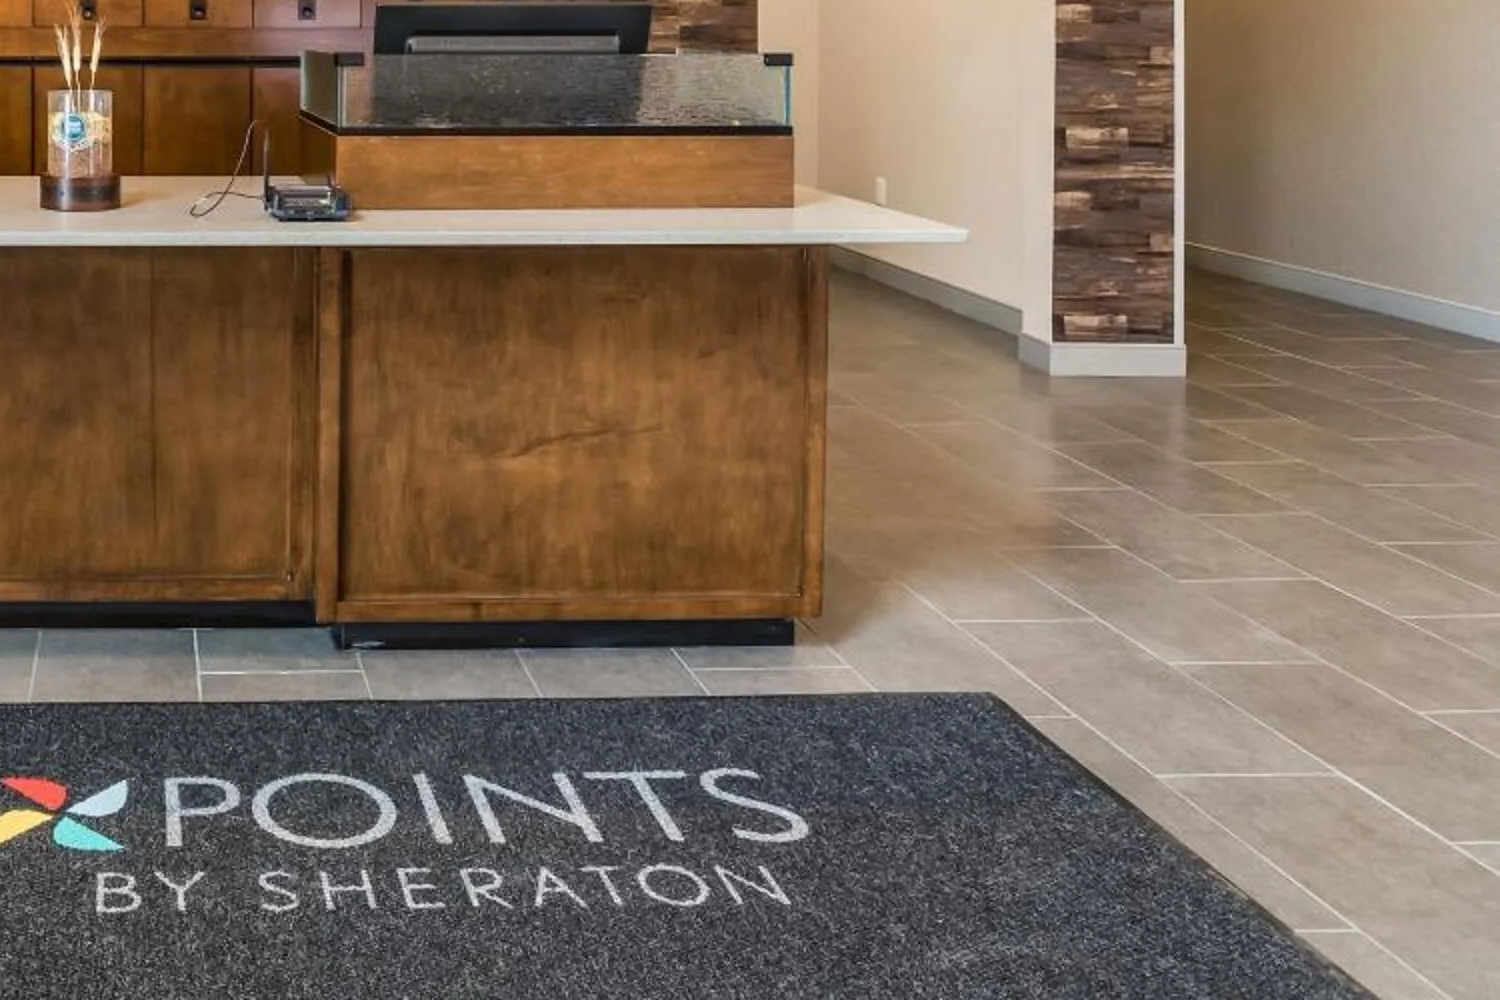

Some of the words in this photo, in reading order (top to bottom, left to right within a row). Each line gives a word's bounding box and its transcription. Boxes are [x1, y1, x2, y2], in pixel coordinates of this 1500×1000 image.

[162, 767, 810, 849] POINTS
[94, 870, 205, 914] BY
[256, 863, 793, 912] SHERATON
